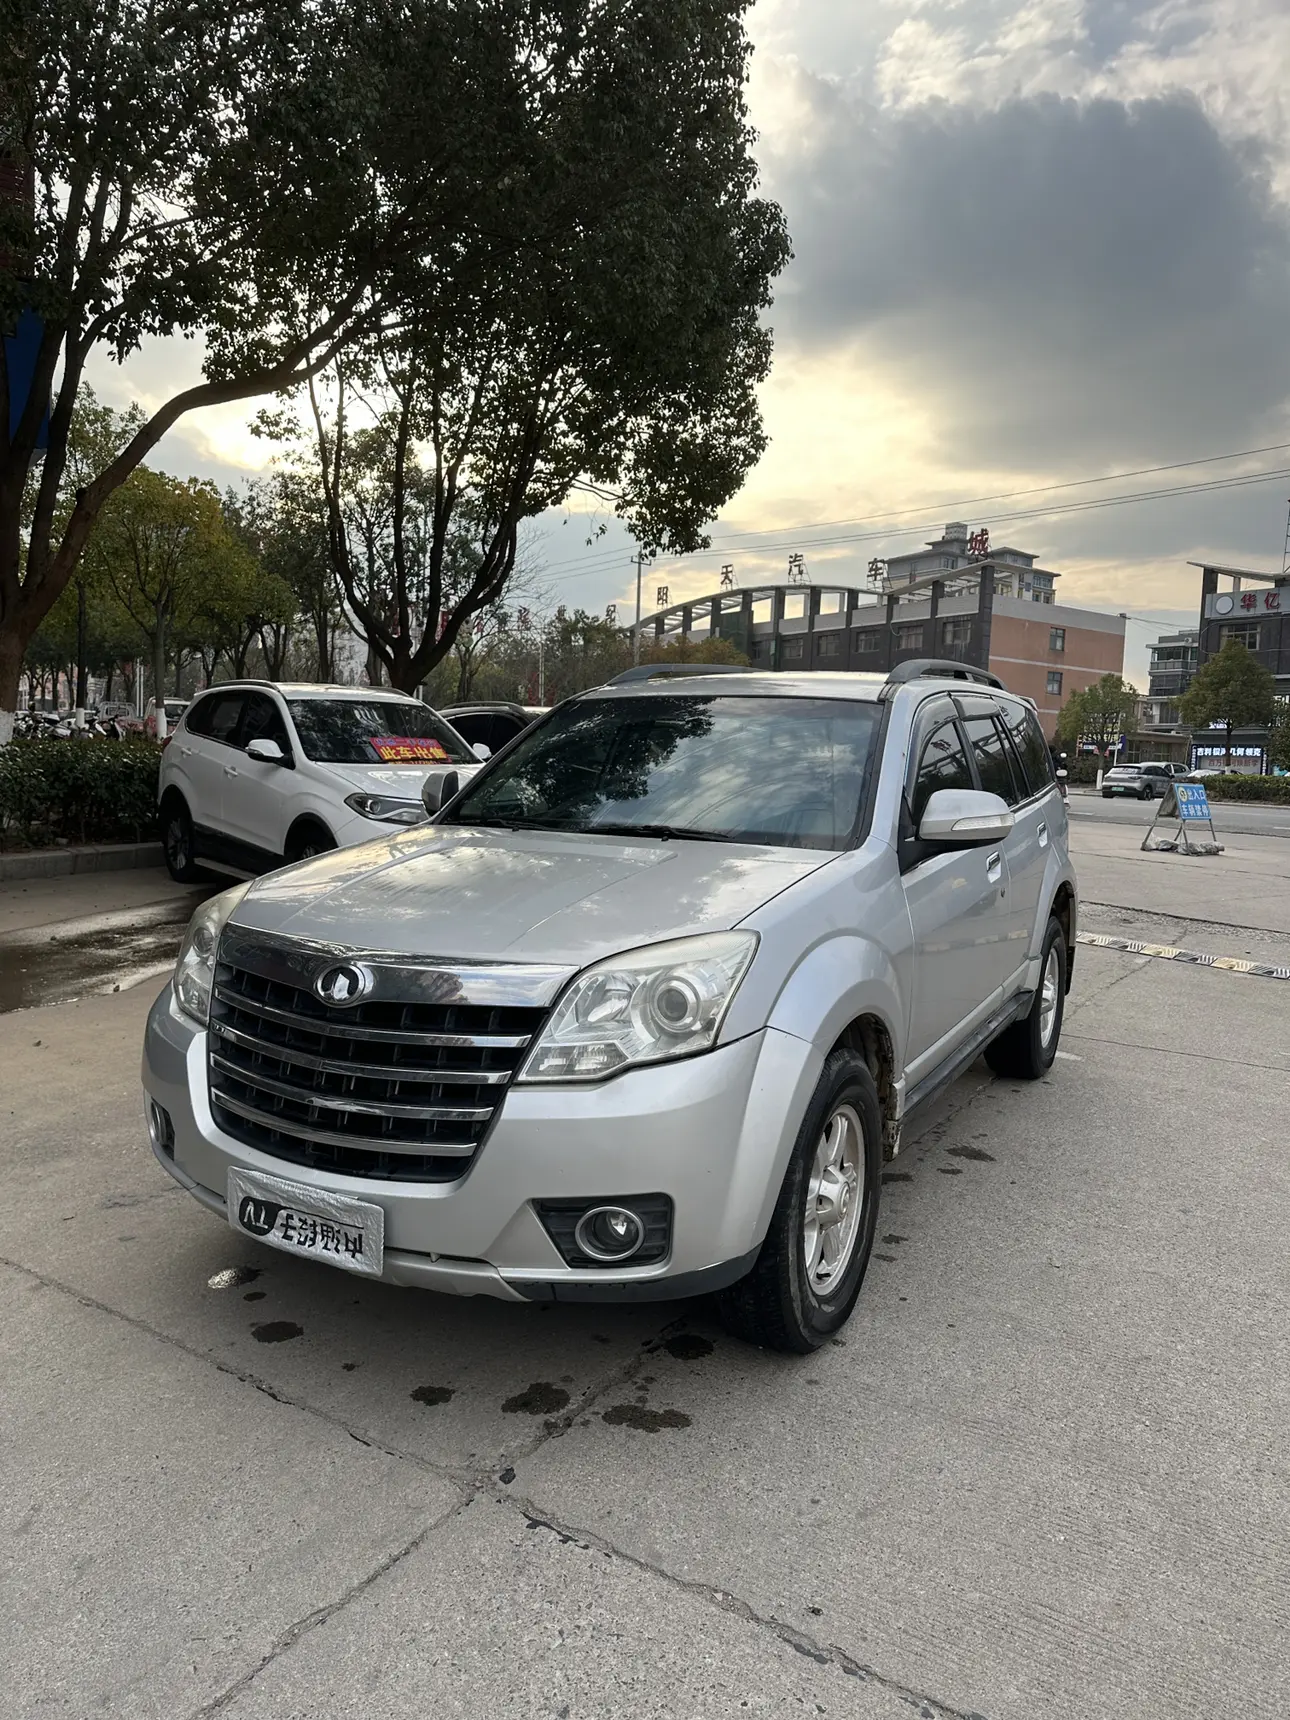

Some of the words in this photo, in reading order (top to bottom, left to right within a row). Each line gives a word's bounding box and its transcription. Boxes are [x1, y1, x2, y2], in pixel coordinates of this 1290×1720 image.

[1240, 592, 1281, 612] 华亿
[380, 745, 447, 760] 此车出售
[1187, 788, 1206, 800] 出入口
